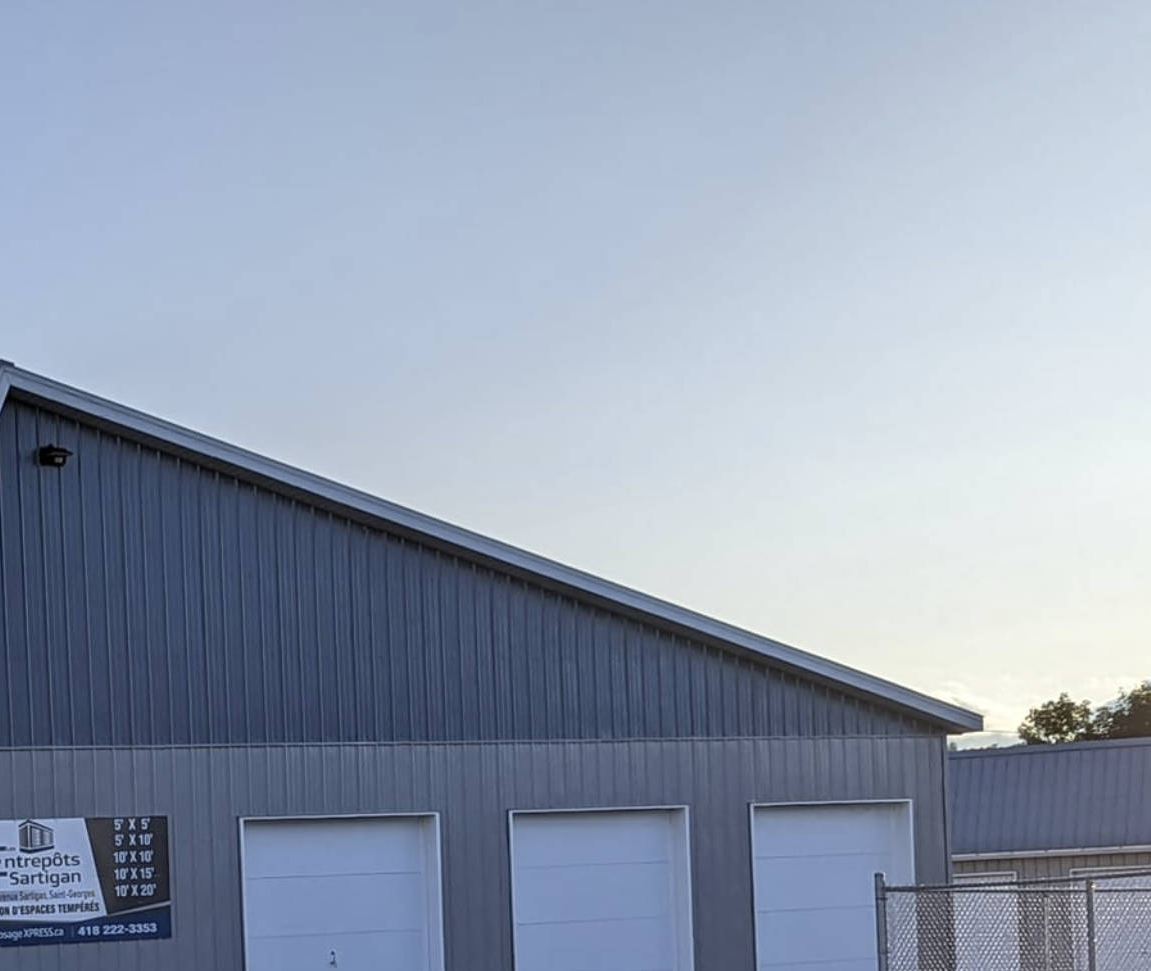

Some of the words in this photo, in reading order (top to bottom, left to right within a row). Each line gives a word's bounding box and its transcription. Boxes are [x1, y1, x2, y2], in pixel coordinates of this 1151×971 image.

[128, 818, 136, 830] X
[114, 834, 125, 847] 5'
[129, 834, 137, 846] X
[138, 832, 154, 845] 10'
[113, 850, 129, 864] 10'
[129, 850, 137, 863] X
[138, 850, 154, 862] 10'
[9, 870, 82, 888] Sartigan
[114, 867, 129, 880] 10'
[130, 867, 138, 880] X
[140, 867, 155, 879] 15'
[115, 884, 130, 897] 10'
[131, 884, 139, 897] X
[140, 883, 157, 896] 20'
[12, 904, 56, 915] D'ESPACES
[58, 901, 100, 913] TEMPÉRÉS
[77, 926, 100, 936] 418
[102, 923, 158, 935] 222-3353
